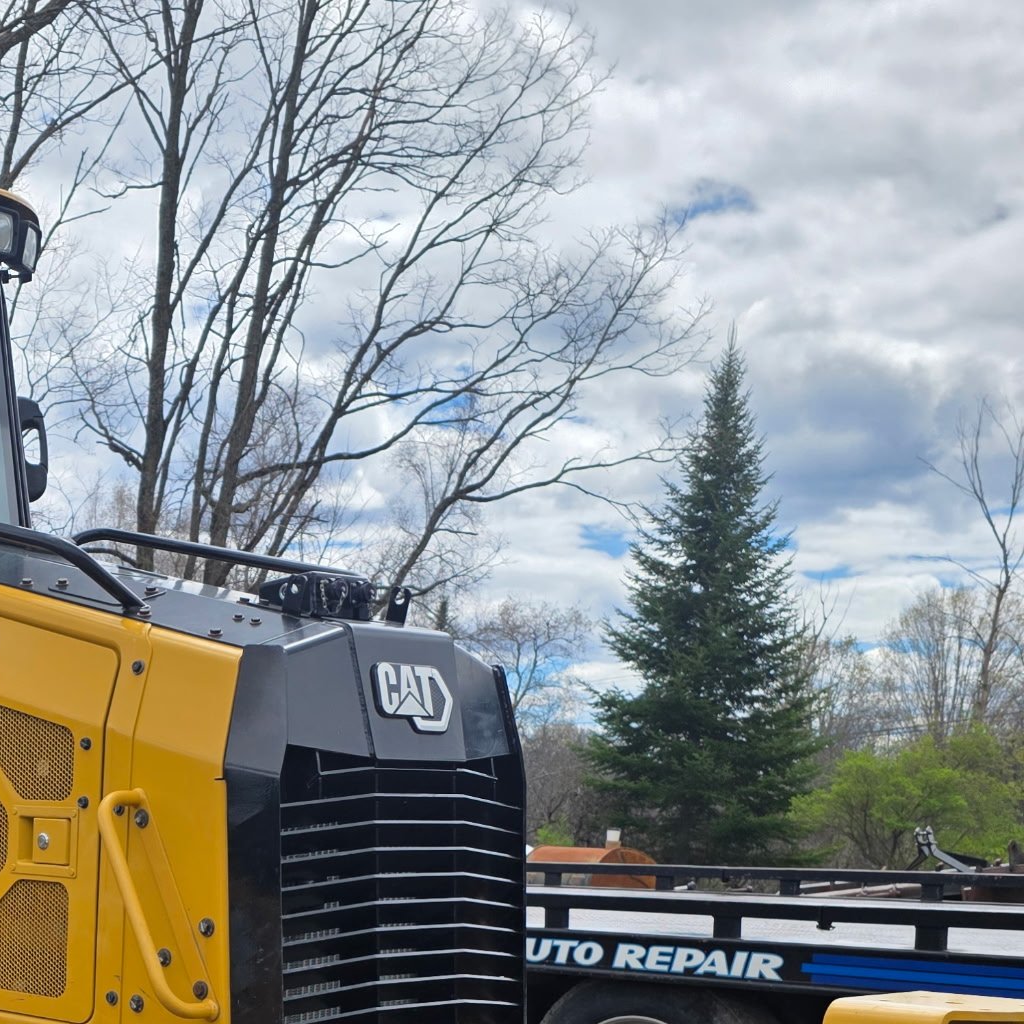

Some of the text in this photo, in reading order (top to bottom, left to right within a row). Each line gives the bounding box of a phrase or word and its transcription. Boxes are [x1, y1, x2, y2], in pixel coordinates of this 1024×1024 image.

[377, 661, 434, 717] CAT
[525, 937, 784, 982] UTO REPAIR
